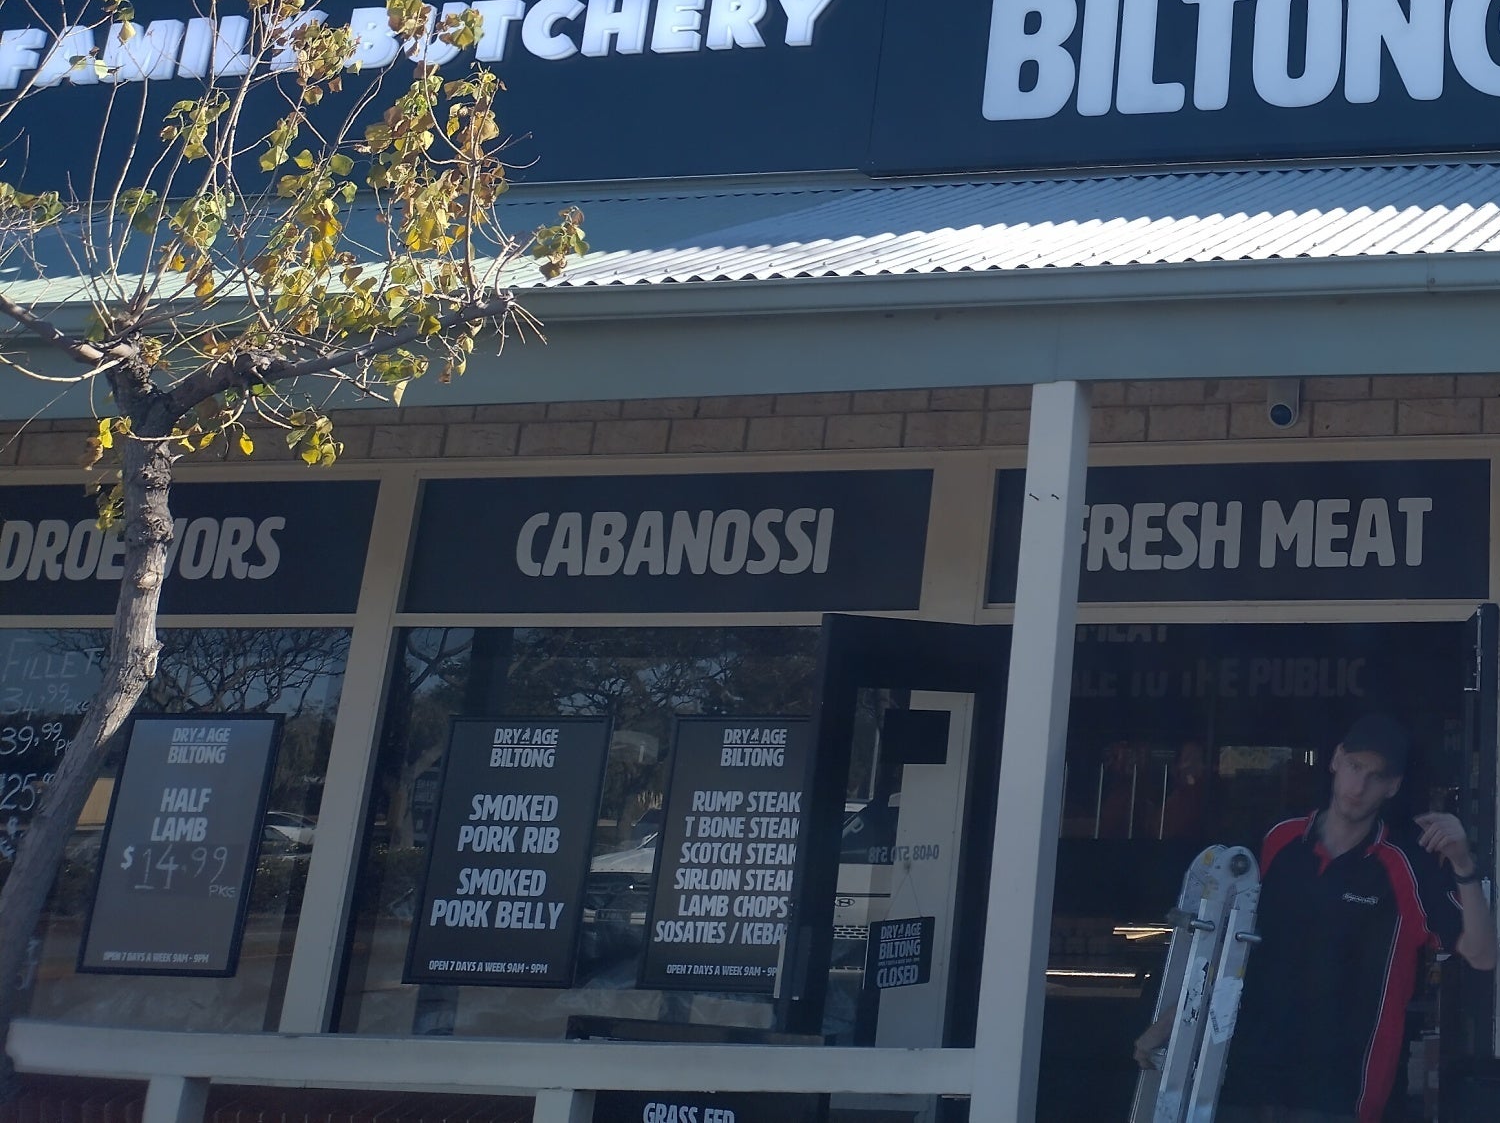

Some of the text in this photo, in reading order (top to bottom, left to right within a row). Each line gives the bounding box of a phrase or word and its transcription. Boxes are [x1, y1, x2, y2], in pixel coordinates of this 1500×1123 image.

[515, 508, 834, 576] CABANOSSI
[1259, 498, 1432, 569] MEAT
[0, 517, 286, 581] DROEORS
[2, 638, 105, 682] FILLET
[1248, 656, 1366, 698] PUBLIC
[172, 728, 231, 743] DRY AGE
[494, 728, 559, 745] DRY AGE
[723, 729, 787, 745] DRY AGE
[167, 745, 227, 764] BILTONG
[490, 748, 556, 768] BILTONG
[720, 748, 785, 767] BILTONG
[160, 787, 213, 813] HALF
[468, 794, 558, 822] SMOKED
[692, 791, 802, 813] RUMP STEAK
[151, 816, 209, 843] LAMB
[685, 816, 695, 837] T
[698, 816, 745, 838] BONE
[457, 825, 561, 854] PORK RIB
[680, 843, 743, 864] SCOTCH
[456, 868, 546, 897] SMOKED
[674, 868, 742, 890] SIRLOIN
[429, 900, 564, 930] PORK BELLY
[678, 894, 789, 918] LAMB CHOPS
[654, 920, 726, 944] SOSATIES
[741, 922, 788, 945] KEBA
[880, 923, 922, 940] DRY AGE
[879, 940, 921, 960] BILTONG
[429, 960, 449, 971] OPEN
[456, 961, 476, 972] DAYS
[484, 962, 507, 973] WEEK
[507, 963, 525, 973] 9AM
[530, 963, 549, 974] 9PM
[666, 964, 686, 975] OPEN
[693, 965, 713, 976] DAYS
[721, 966, 743, 977] WEEK
[743, 966, 761, 977] 9AM
[767, 967, 777, 977] 9P
[876, 965, 919, 988] CLOSED
